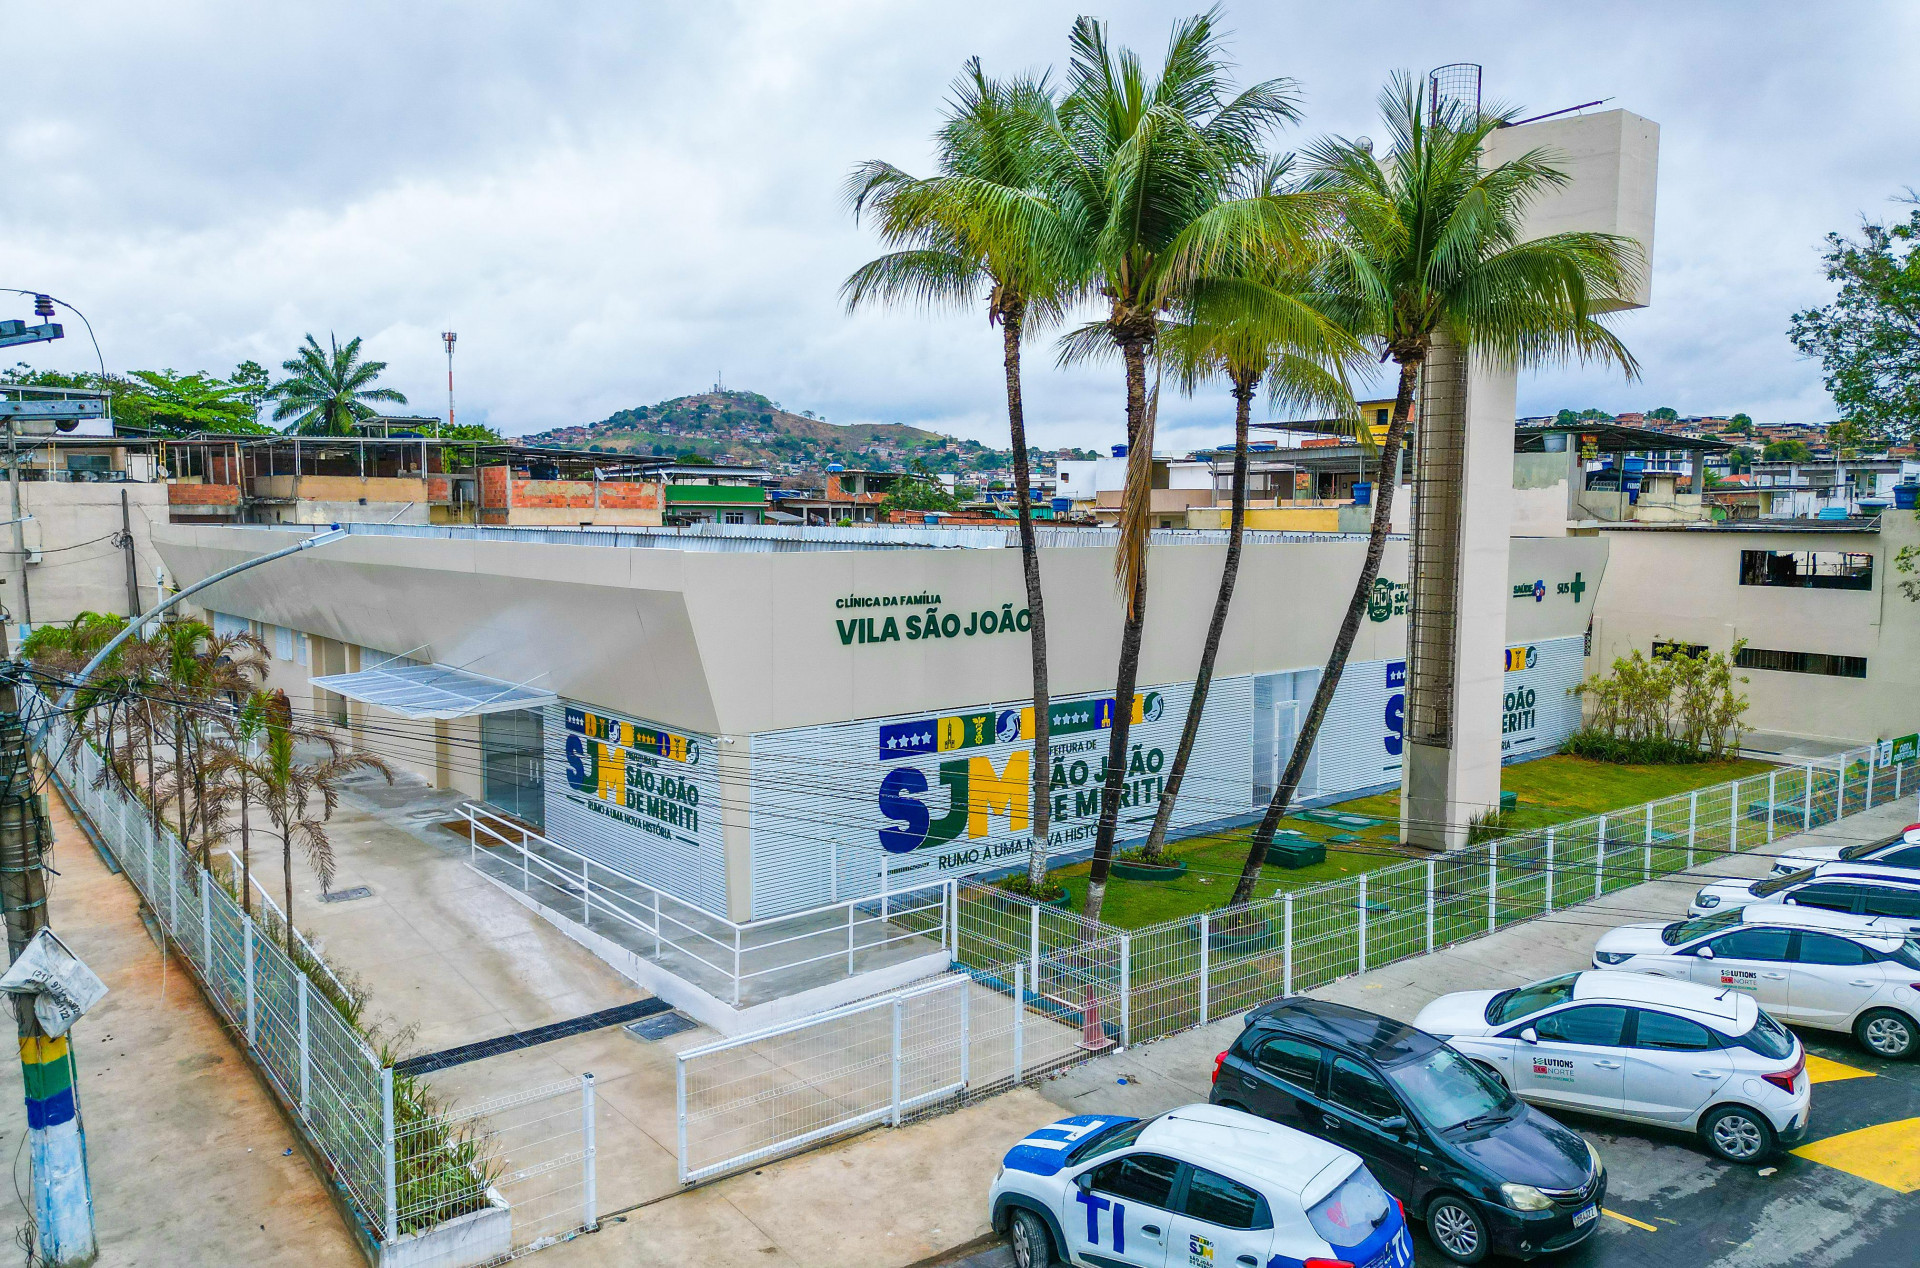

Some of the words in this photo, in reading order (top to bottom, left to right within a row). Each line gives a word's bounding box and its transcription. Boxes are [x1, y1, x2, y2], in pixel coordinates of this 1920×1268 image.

[835, 594, 880, 608] CLÍNICA
[883, 596, 897, 607] DA
[900, 591, 941, 605] FAMÍLIA
[1557, 583, 1569, 594] SUS
[836, 616, 900, 645] VILA
[906, 607, 961, 640] SÃO
[964, 603, 1031, 636] JOÃO
[565, 734, 626, 806] SJM
[626, 763, 654, 793] SÃO
[656, 776, 699, 807] JOÃO
[588, 800, 605, 814] RUMO
[611, 808, 623, 822] UMA
[624, 814, 642, 829] NOVA
[643, 821, 671, 840] HISTÓRIA
[626, 788, 643, 813] DE
[647, 795, 698, 832] MERITI
[878, 750, 1030, 854] SJM
[939, 849, 979, 870] RUMO
[983, 846, 991, 860] A
[994, 839, 1023, 857] UMA
[1076, 1190, 1125, 1255] TI
[1189, 1241, 1213, 1260] SJM
[1392, 1225, 1411, 1268] TI
